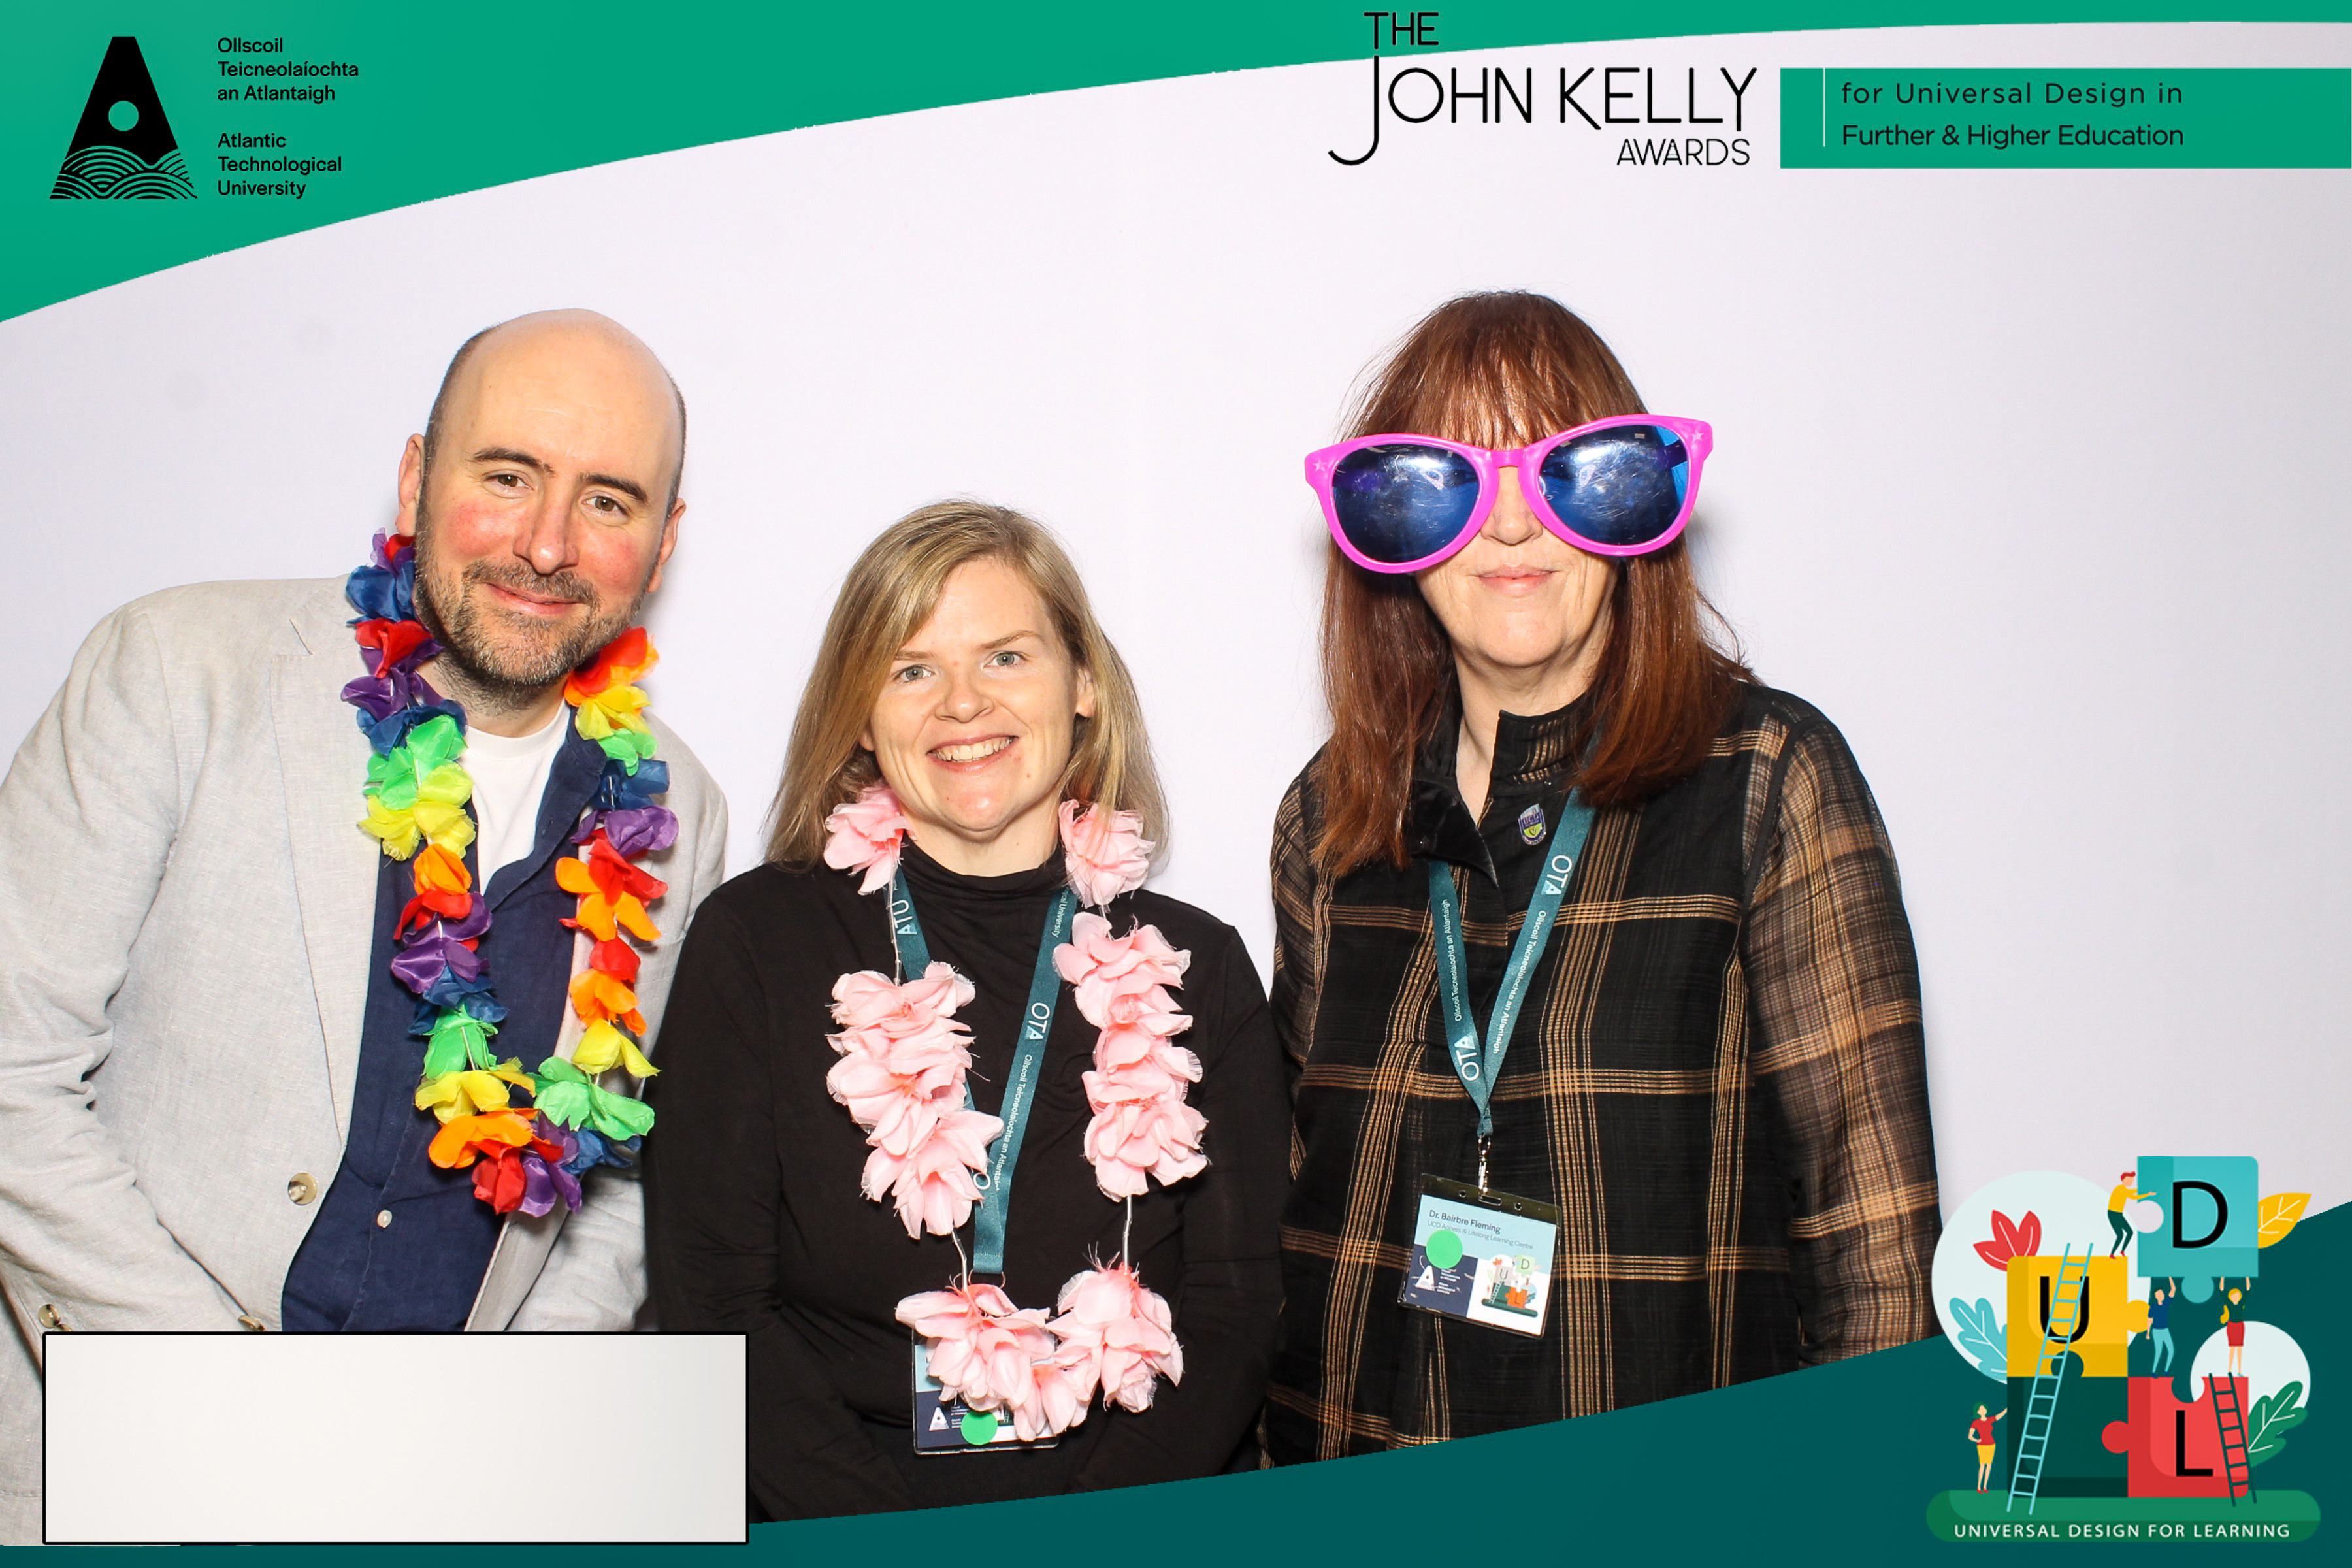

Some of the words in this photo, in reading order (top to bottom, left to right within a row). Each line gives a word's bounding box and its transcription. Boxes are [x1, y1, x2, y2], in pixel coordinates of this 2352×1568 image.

[1051, 904, 1067, 938] University
[1428, 1209, 1439, 1219] Dr.
[1441, 1213, 1469, 1226] Bairbre
[1470, 1219, 1501, 1235] Fleming
